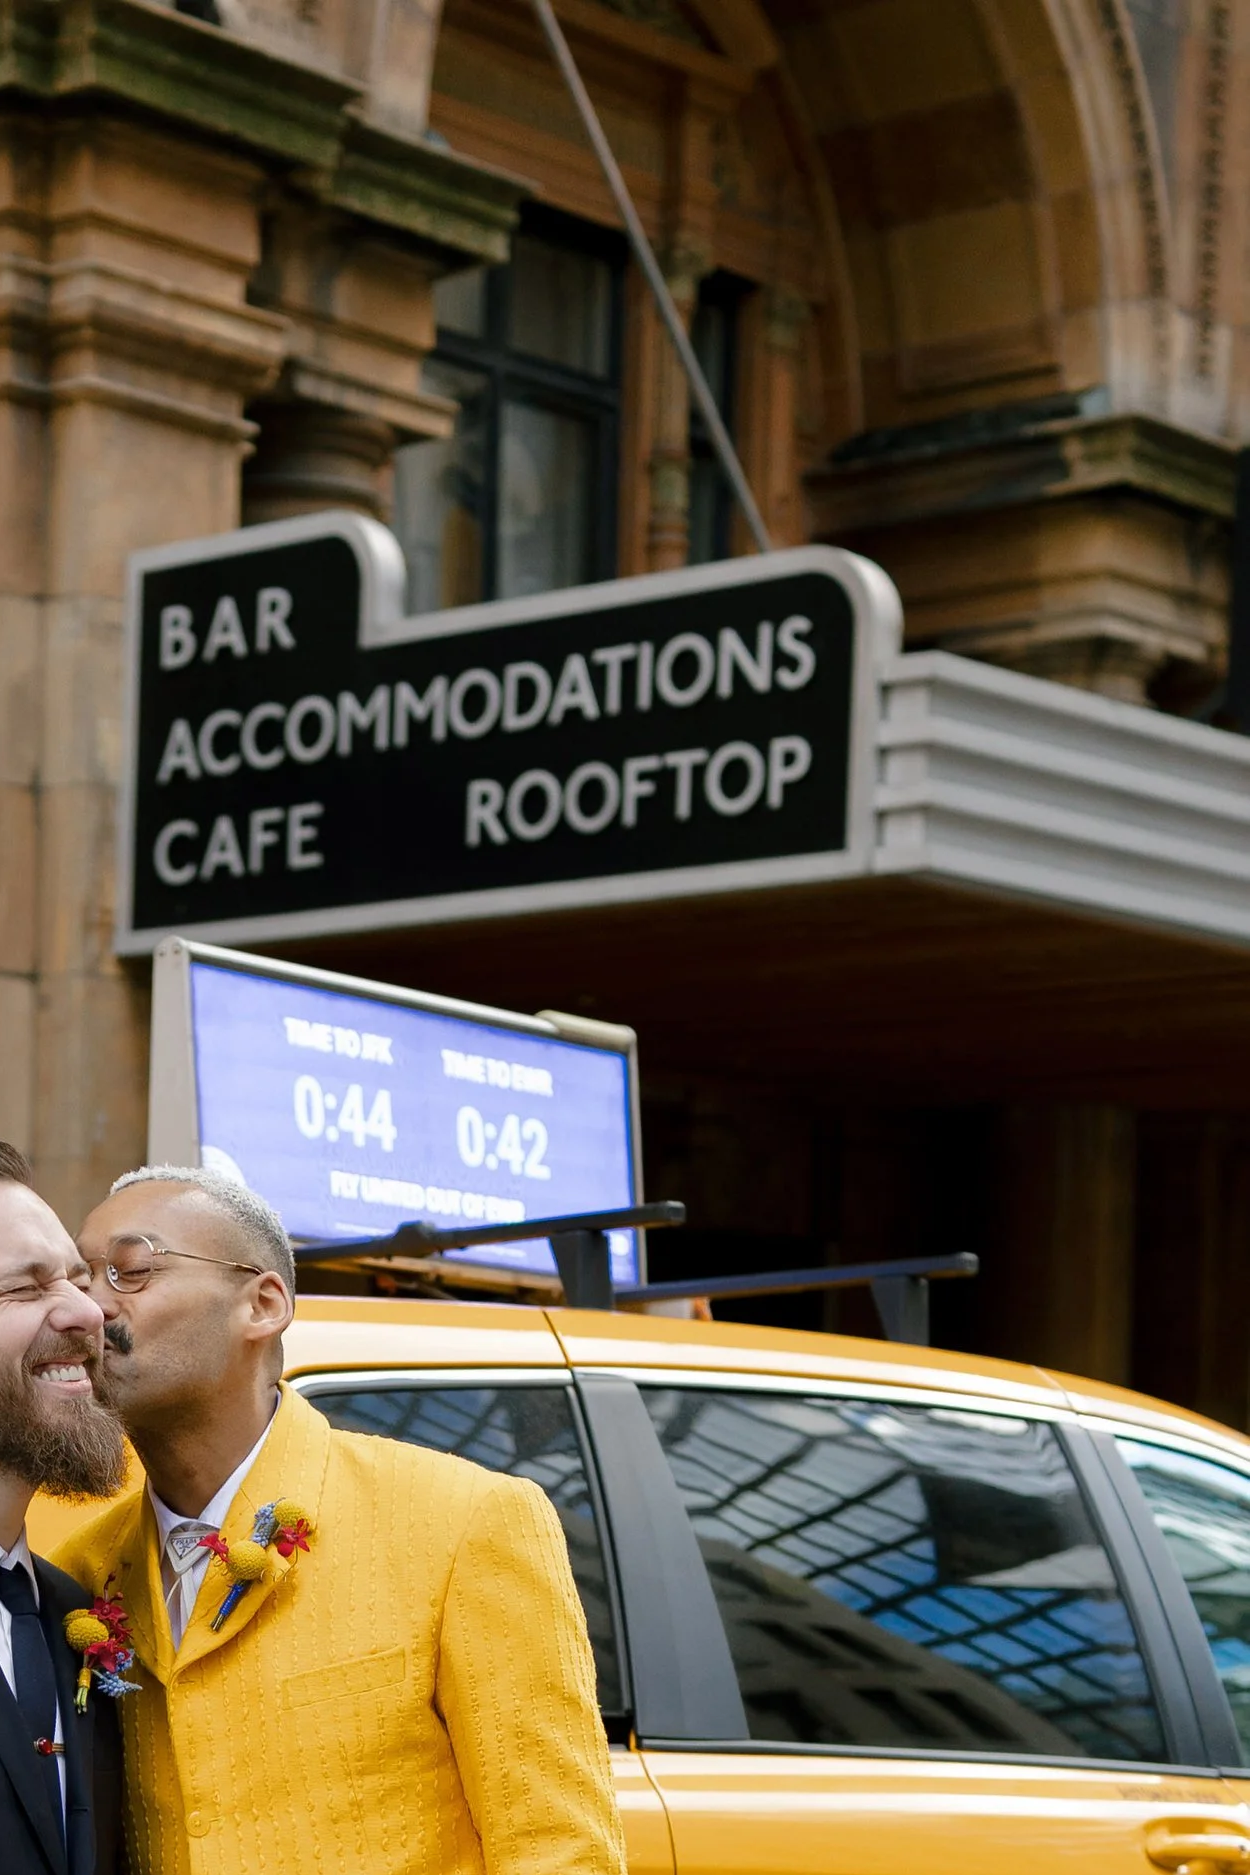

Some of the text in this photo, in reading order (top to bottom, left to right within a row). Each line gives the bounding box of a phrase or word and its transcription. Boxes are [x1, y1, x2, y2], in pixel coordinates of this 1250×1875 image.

[159, 587, 297, 671] BAR
[155, 614, 817, 785] ACCOMMODATIONS
[465, 735, 813, 848] ROOFTOP
[153, 802, 324, 886] CAFE
[334, 1027, 361, 1059] TO
[486, 1058, 510, 1089] TO
[293, 1074, 398, 1153] 0:44
[456, 1105, 551, 1181] 0:42
